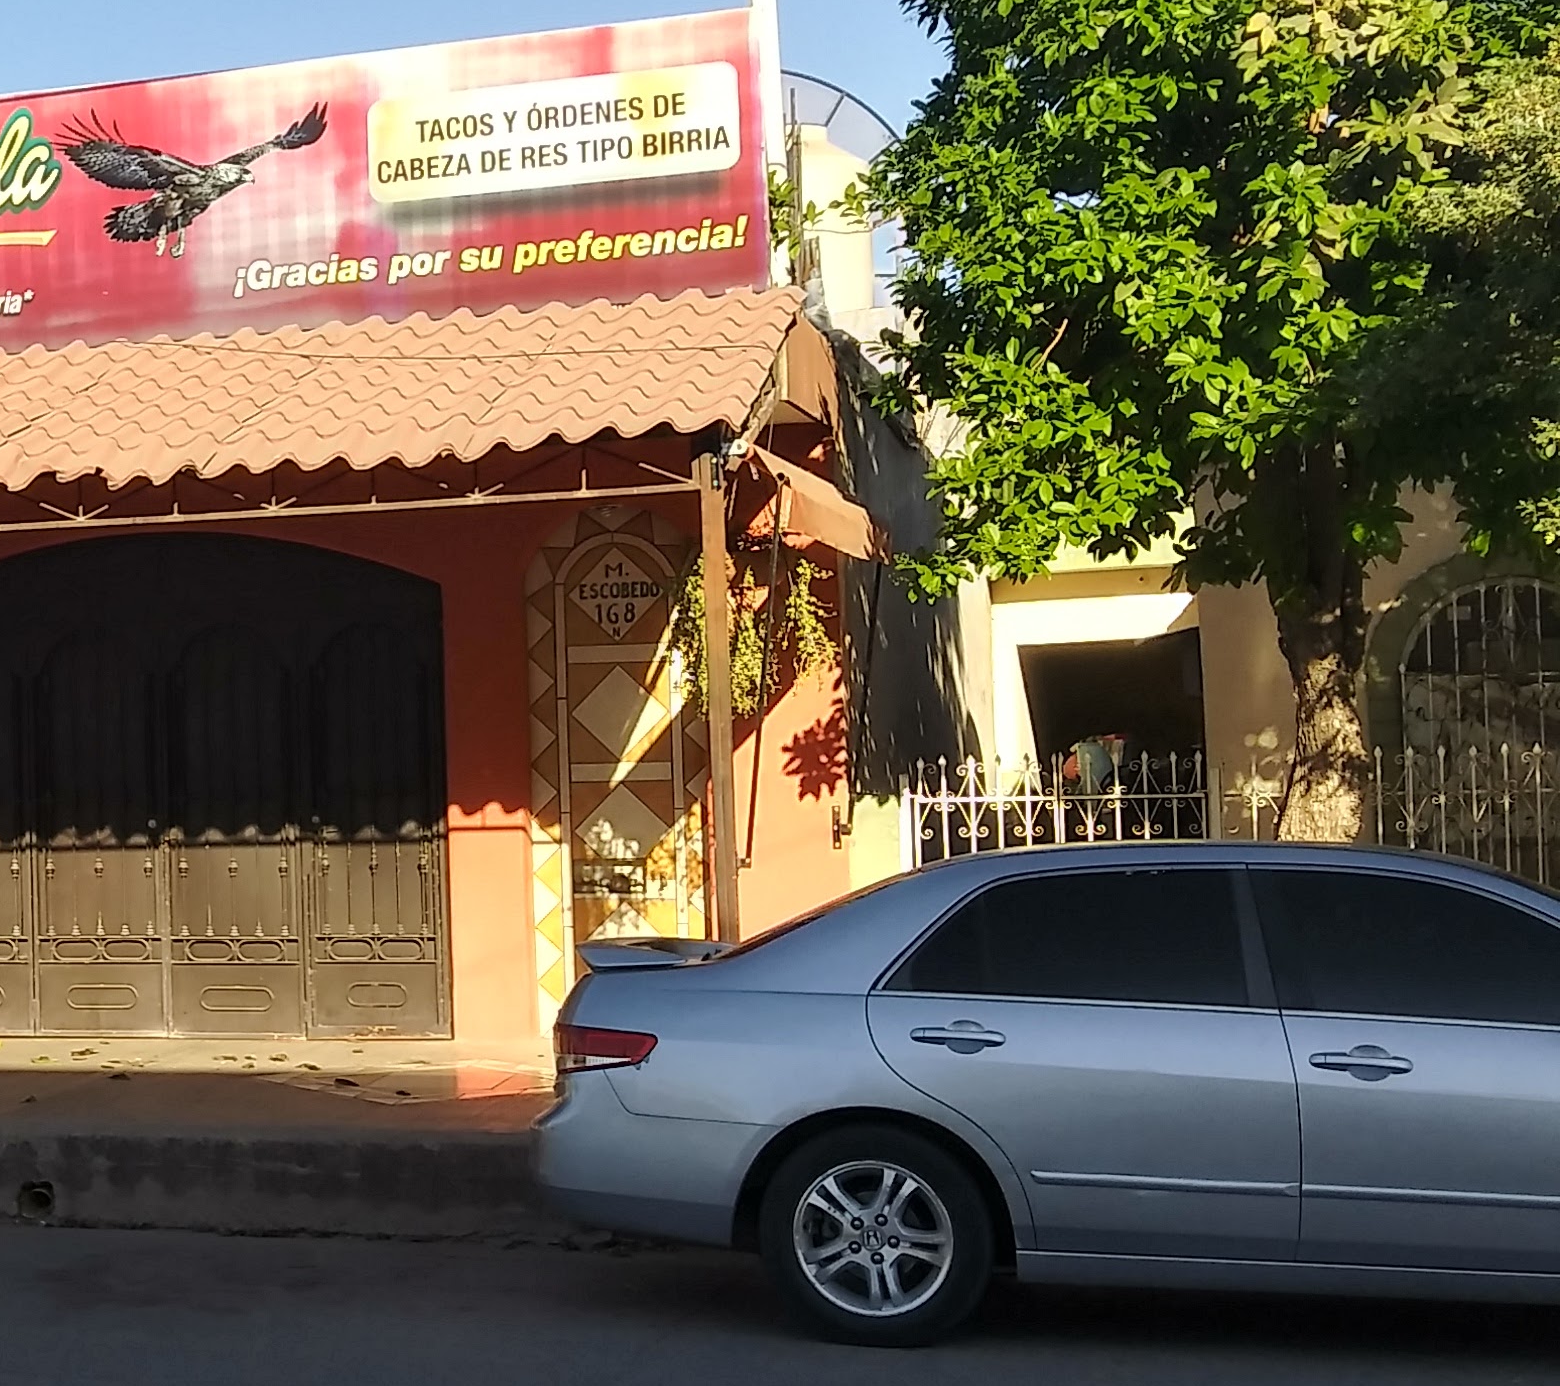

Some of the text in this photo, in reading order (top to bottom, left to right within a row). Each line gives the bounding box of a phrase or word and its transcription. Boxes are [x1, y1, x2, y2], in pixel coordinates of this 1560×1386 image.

[415, 92, 687, 144] TACOS Y ÓRDENES DE
[377, 125, 731, 184] CABEZA DE RES TIPO BIRRIA
[232, 214, 749, 299] ¡Gracias por su preferencia!
[605, 562, 630, 579] M.
[578, 580, 661, 601] ESCOBEDO
[595, 602, 636, 625] 168
[612, 626, 621, 638] N
